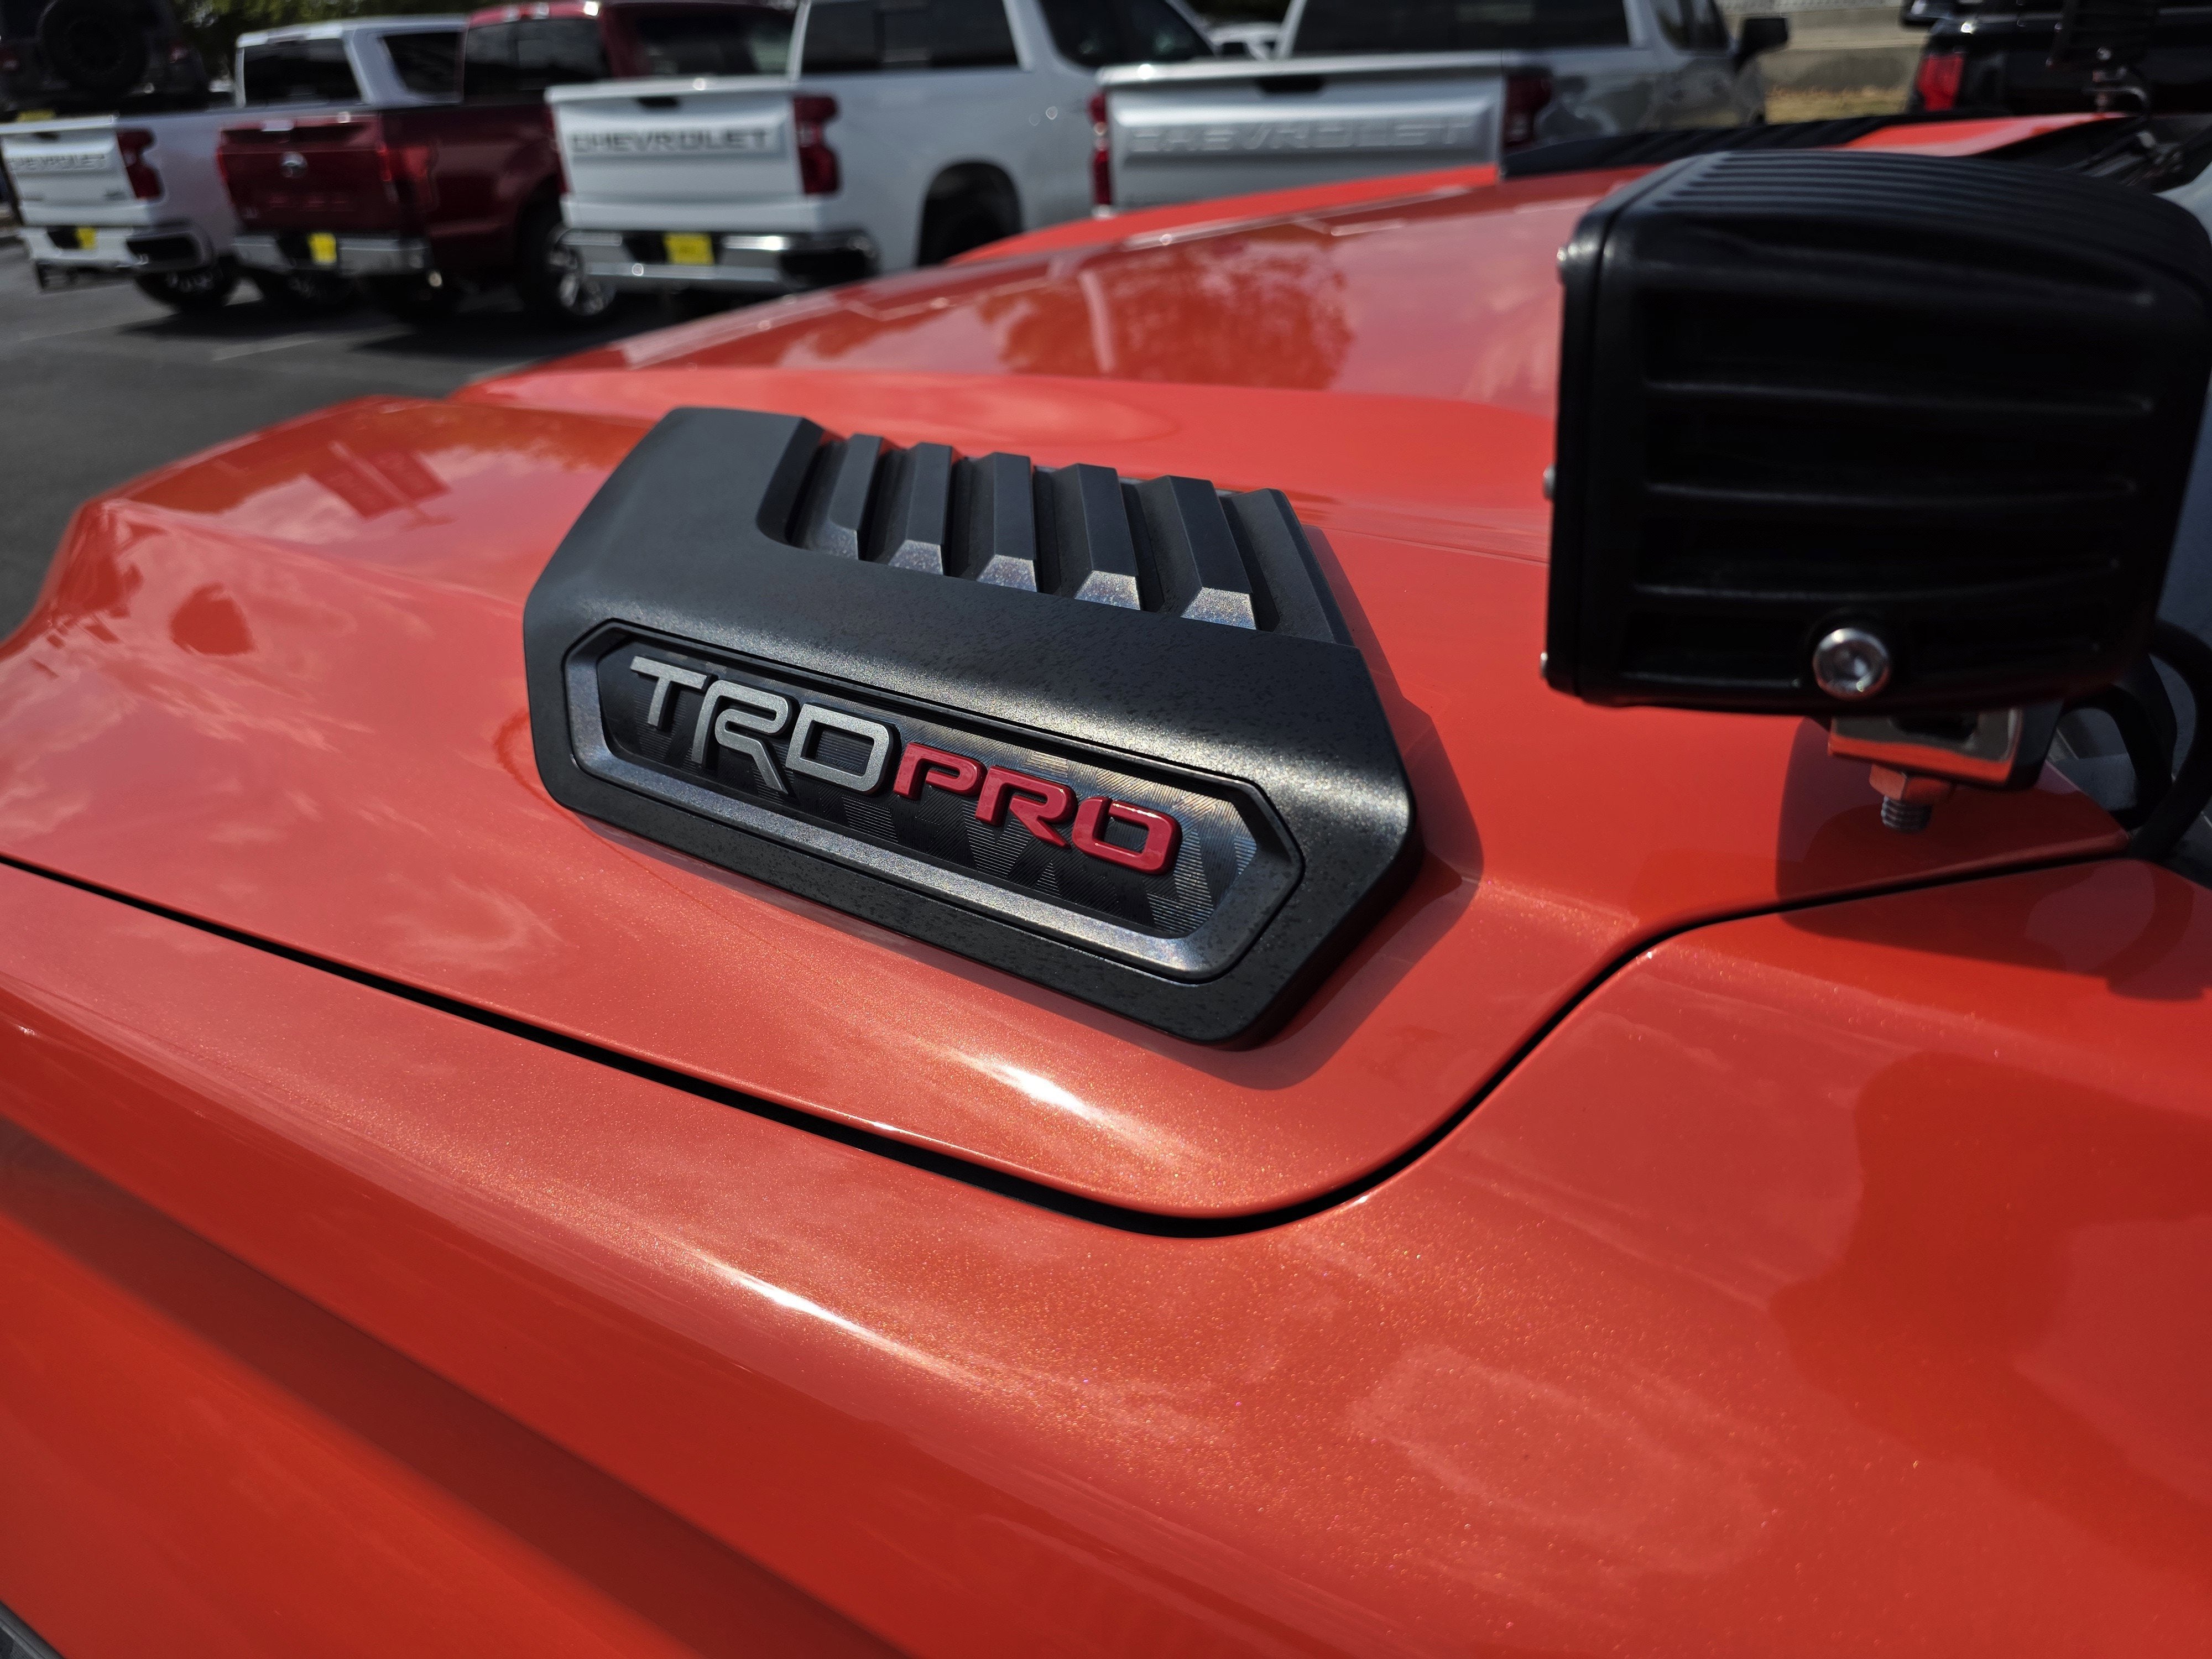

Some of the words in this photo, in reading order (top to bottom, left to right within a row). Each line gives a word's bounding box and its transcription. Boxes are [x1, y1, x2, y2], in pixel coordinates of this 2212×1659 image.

[572, 127, 768, 153] CHEVROLET
[1130, 118, 1473, 152] CHEVROLET
[630, 656, 891, 794] TRD
[892, 742, 1181, 875] PRO
